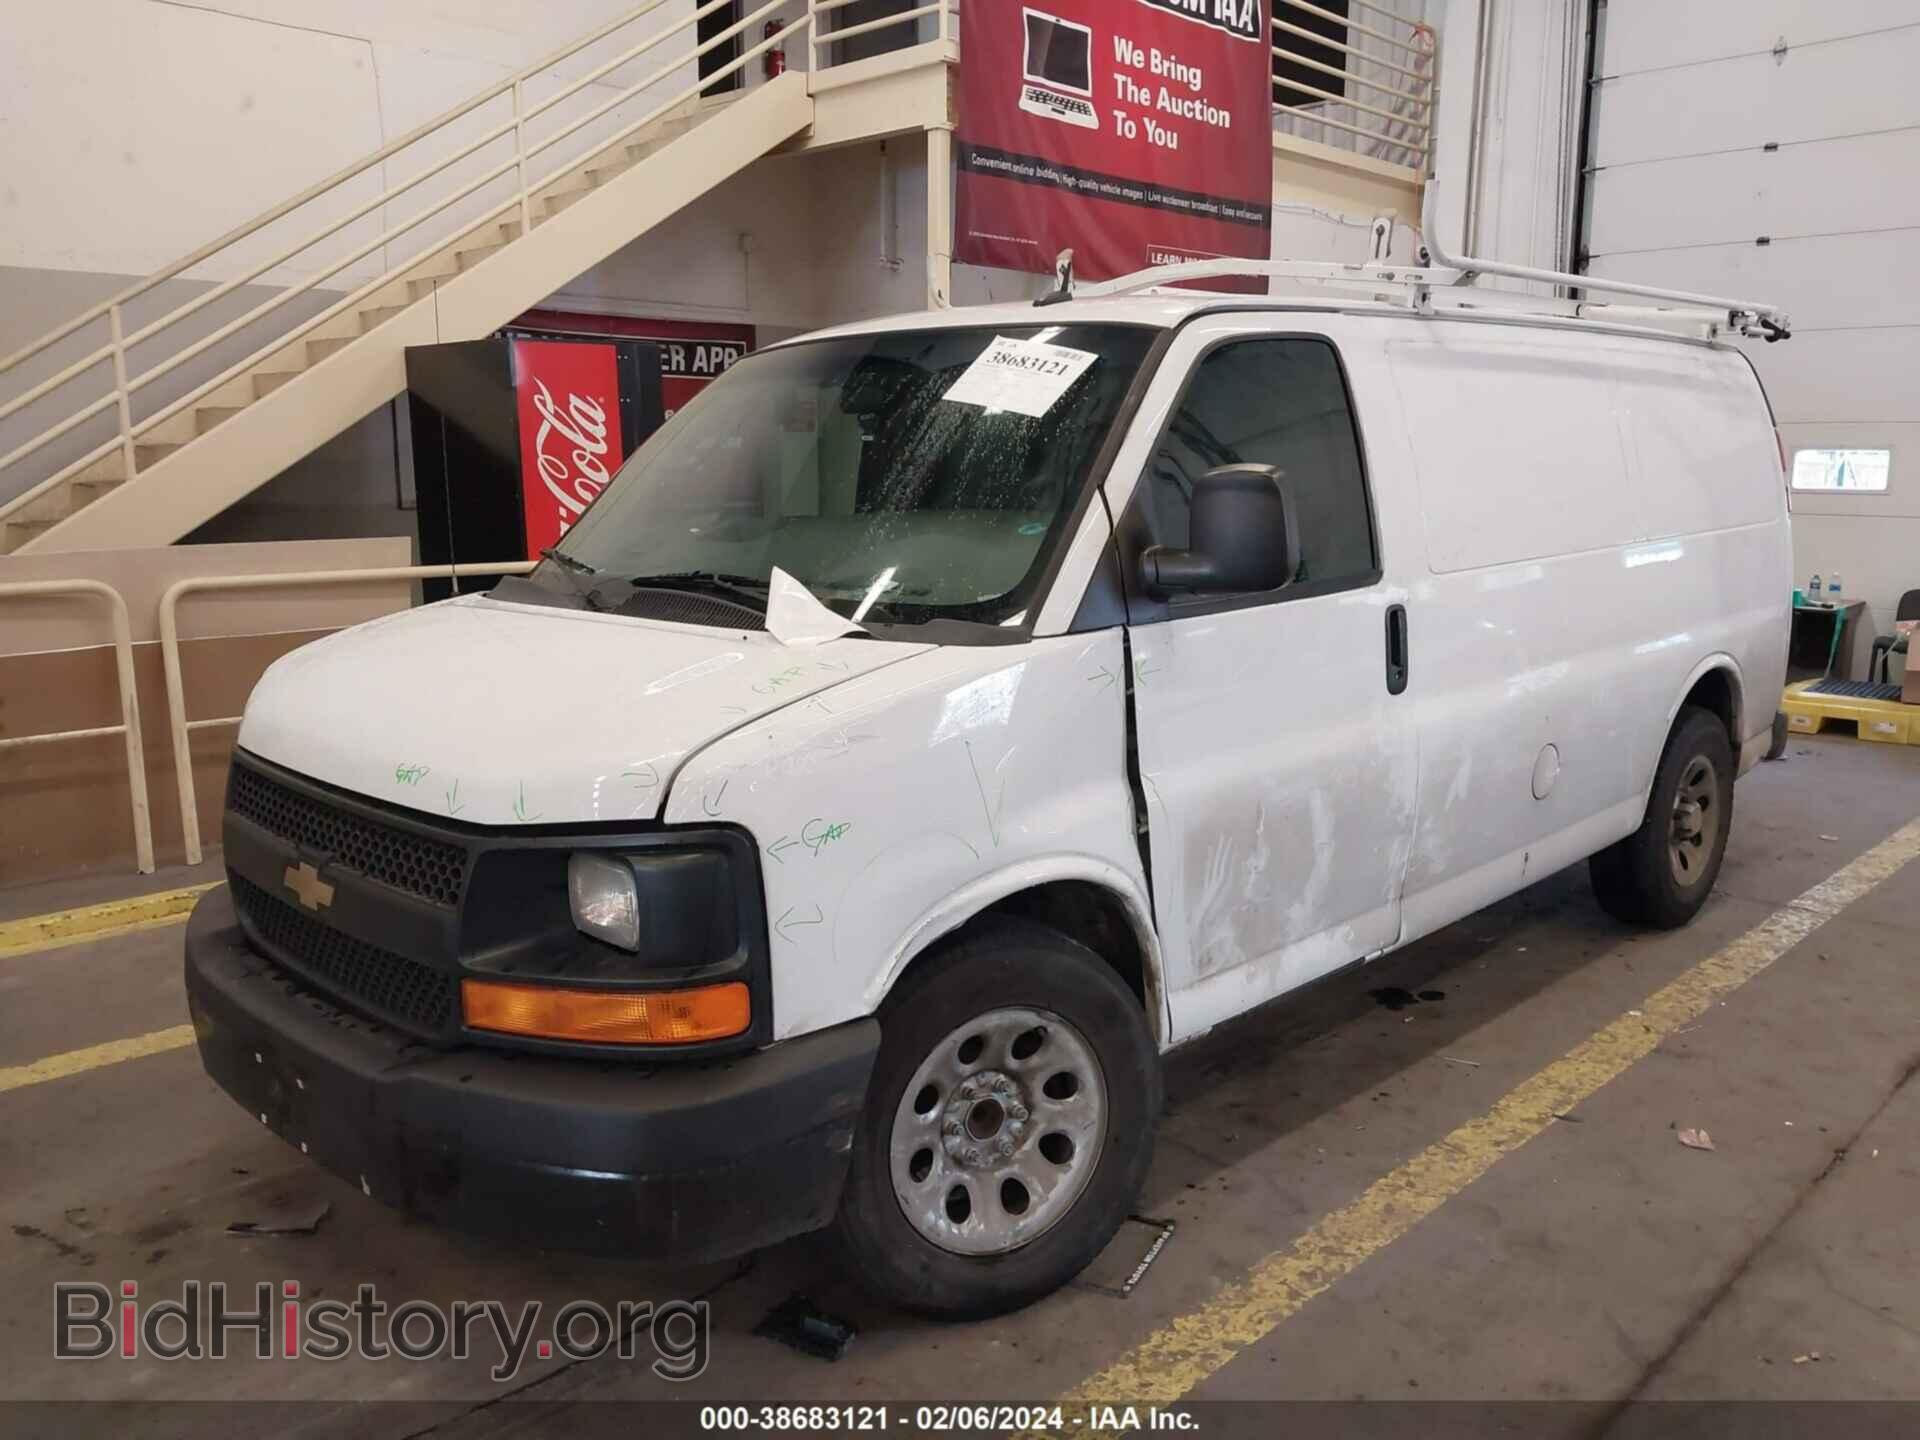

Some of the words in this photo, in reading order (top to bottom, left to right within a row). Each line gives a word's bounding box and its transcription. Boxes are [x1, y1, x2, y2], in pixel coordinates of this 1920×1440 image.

[1113, 35, 1145, 69] We
[1150, 47, 1202, 91] Bring
[1113, 73, 1152, 106] The
[1156, 86, 1231, 128] Auction
[1112, 110, 1137, 139] To
[1142, 117, 1178, 149] You
[1147, 190, 1162, 203] Live
[692, 345, 738, 373] APP
[986, 351, 1069, 376] 38683121
[801, 818, 851, 858] GAP
